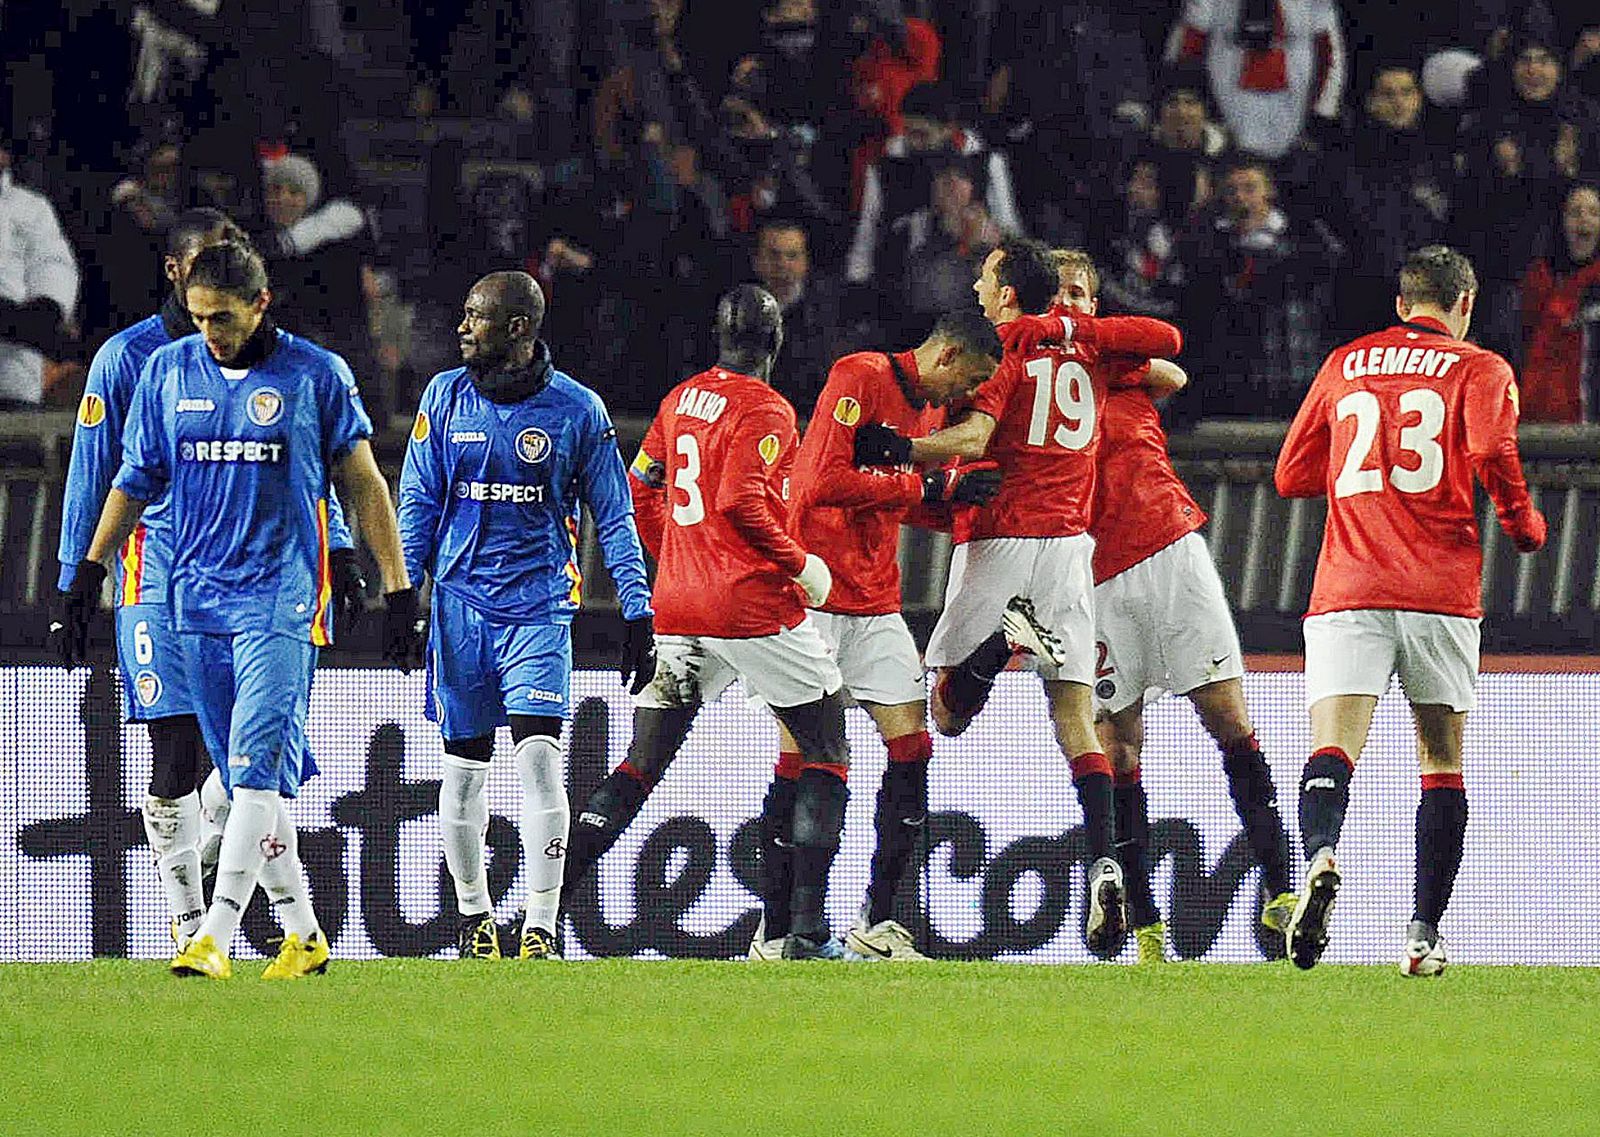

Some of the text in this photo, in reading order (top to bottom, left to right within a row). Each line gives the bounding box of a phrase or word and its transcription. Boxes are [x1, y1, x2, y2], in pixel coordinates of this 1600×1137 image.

[1343, 347, 1460, 380] CLEMENT
[674, 387, 728, 424] SAKHO
[1025, 357, 1096, 451] 19
[195, 440, 282, 462] RESPECT
[1335, 388, 1446, 499] 23
[470, 481, 545, 503] RESPECT
[672, 434, 705, 527] 3
[134, 621, 154, 665] 6
